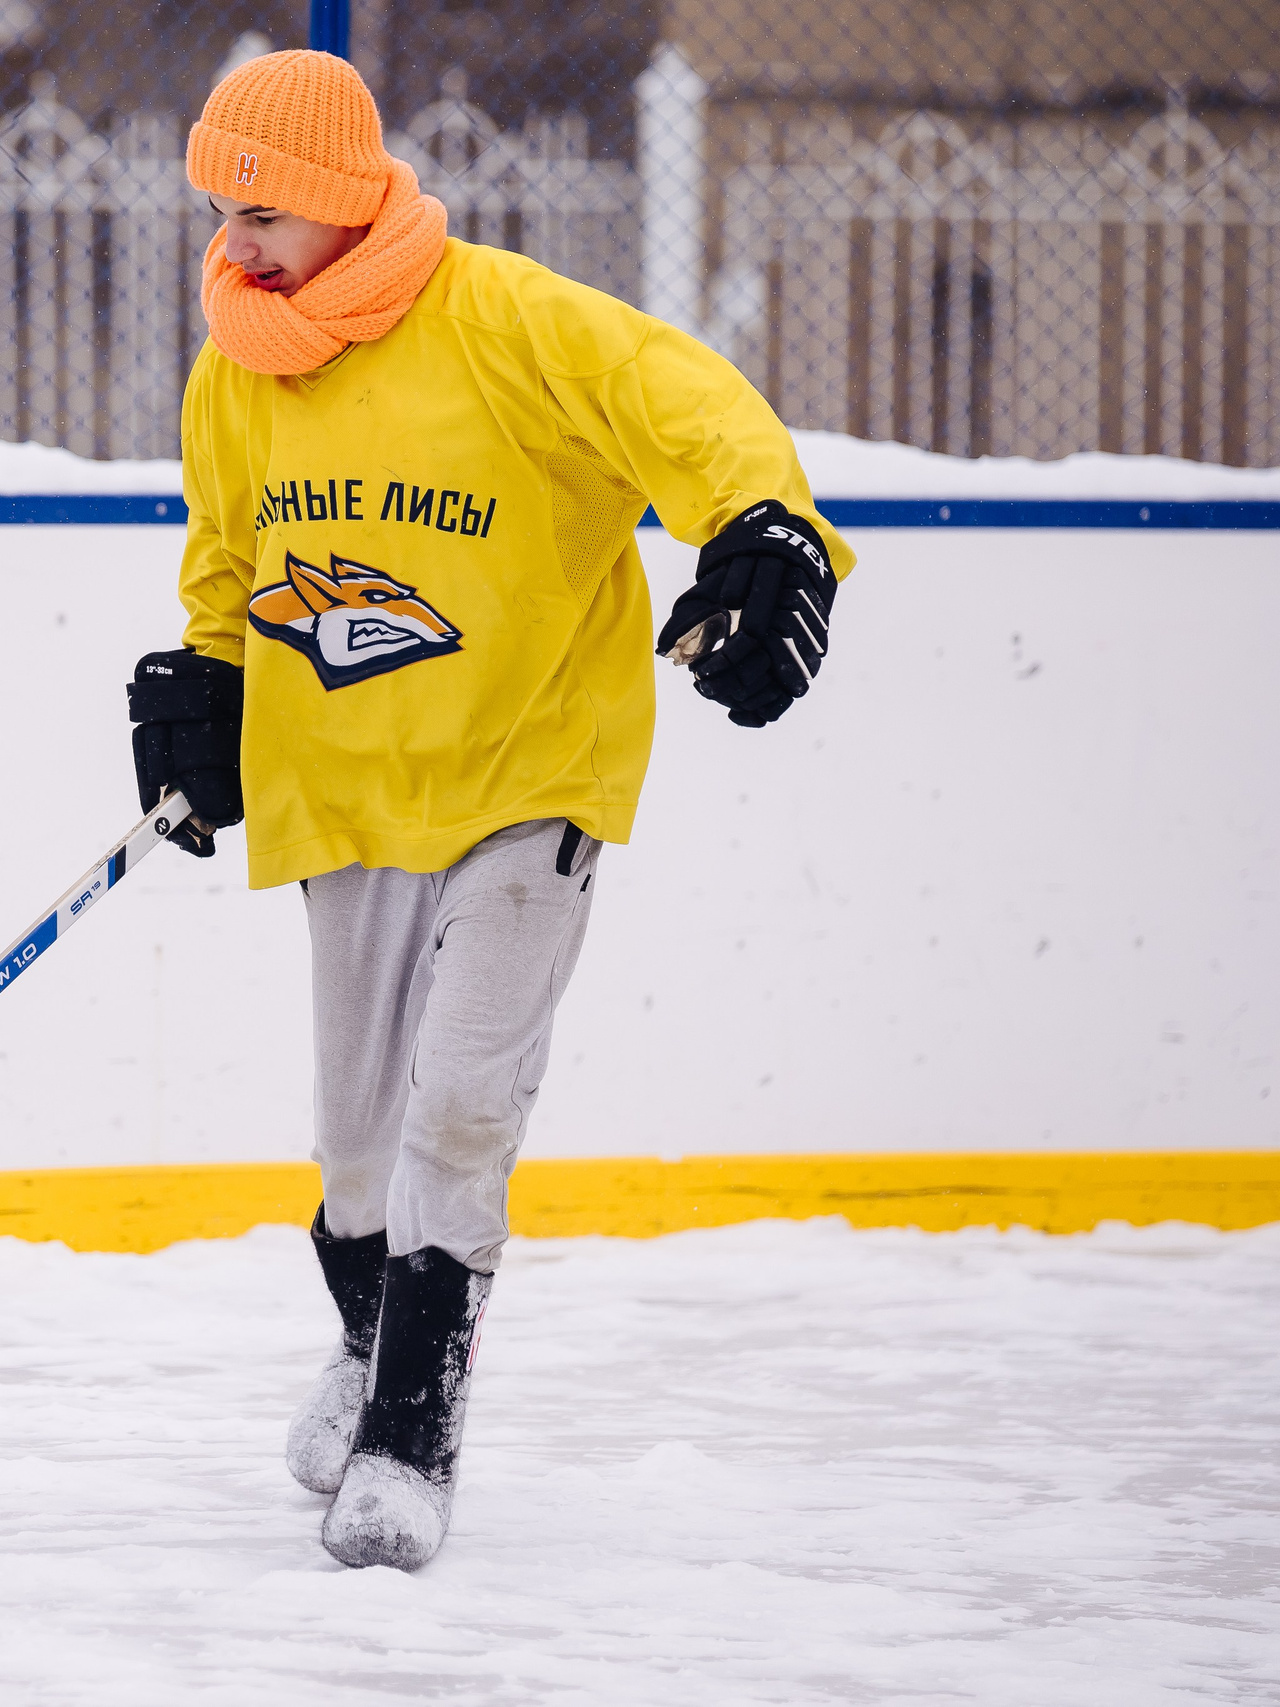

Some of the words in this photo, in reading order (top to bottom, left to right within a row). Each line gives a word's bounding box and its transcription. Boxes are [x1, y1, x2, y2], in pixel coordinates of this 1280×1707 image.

[380, 481, 497, 538] ЛИСЫ
[763, 525, 829, 579] STEX
[13, 943, 37, 969] 1.0
